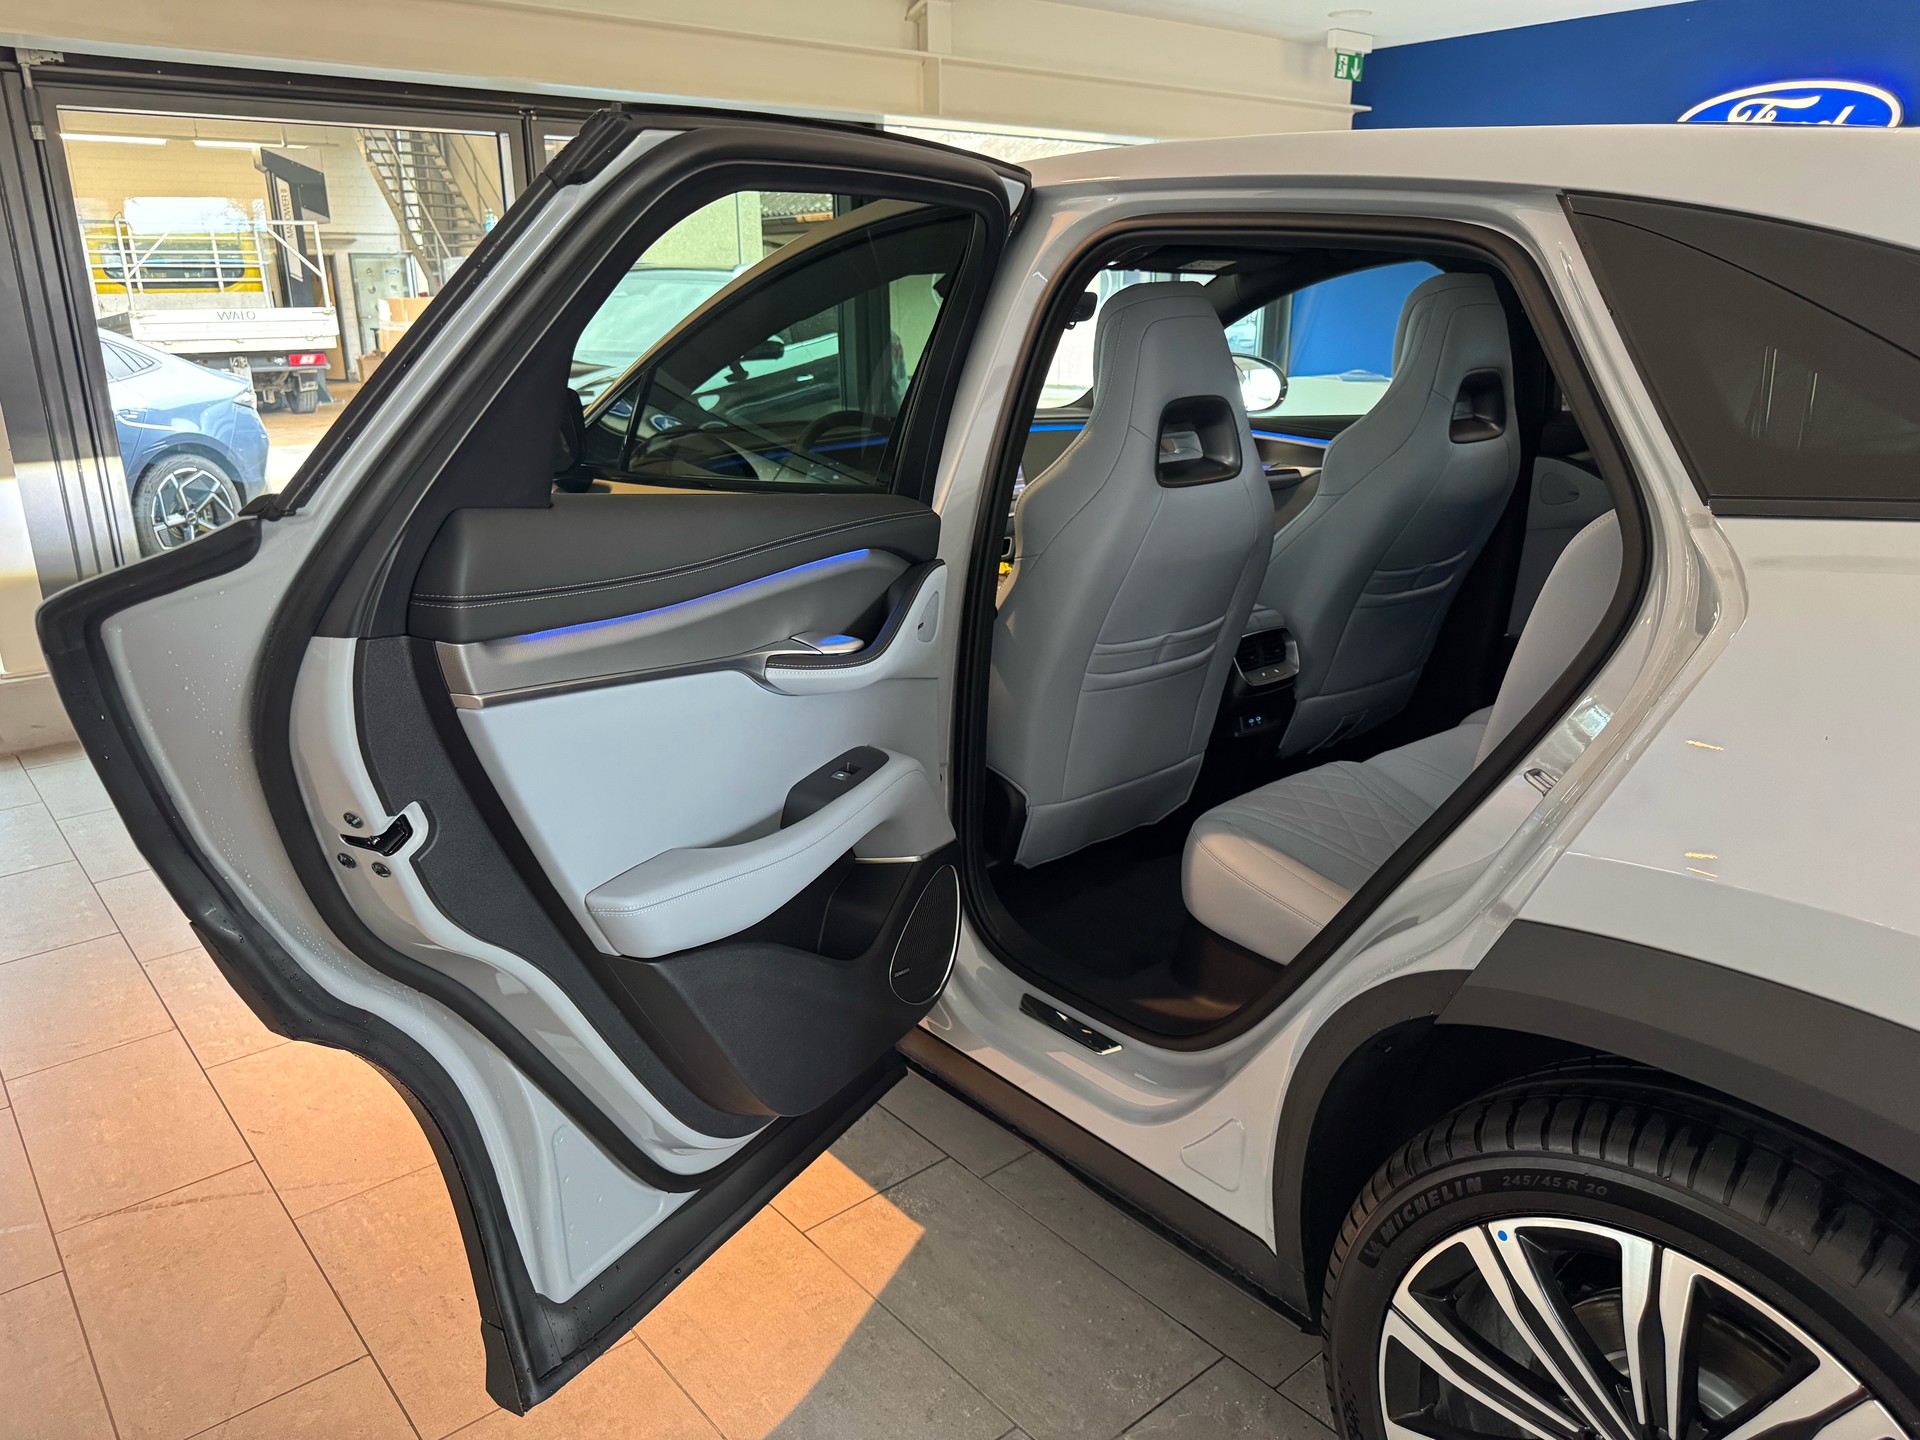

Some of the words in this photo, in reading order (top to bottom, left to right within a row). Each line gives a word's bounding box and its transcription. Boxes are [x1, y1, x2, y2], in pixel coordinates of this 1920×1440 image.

[281, 194, 294, 239] MAOWER
[217, 310, 256, 321] WALO
[1502, 1174, 1562, 1189] 245/45
[1566, 1179, 1579, 1191] R
[1584, 1183, 1608, 1197] 20
[1379, 1175, 1483, 1243] MICHELIN
